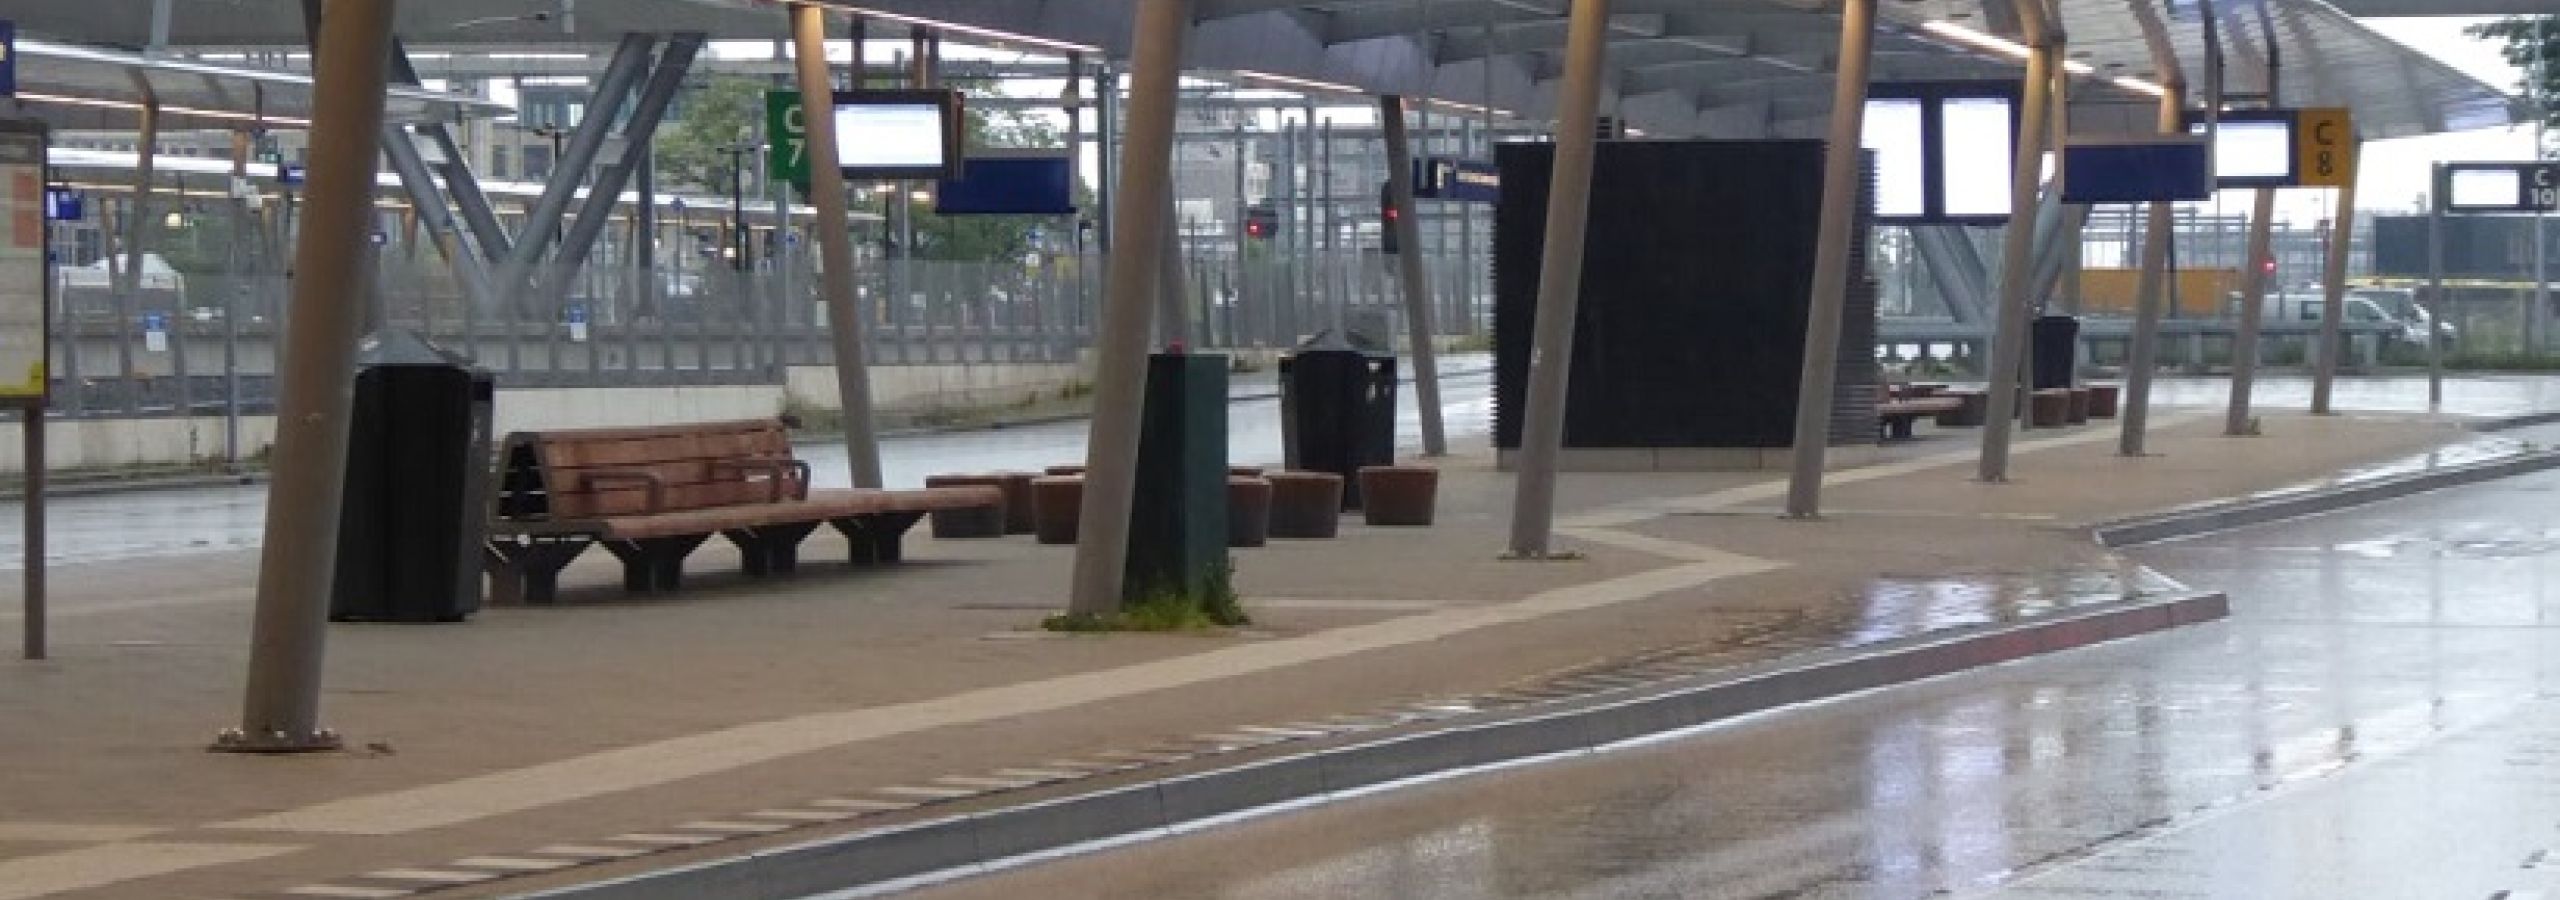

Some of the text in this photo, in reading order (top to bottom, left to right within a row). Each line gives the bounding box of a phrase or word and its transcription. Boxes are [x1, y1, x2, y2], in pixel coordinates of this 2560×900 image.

[784, 103, 805, 133] C
[2314, 120, 2334, 145] C
[786, 138, 805, 167] 7
[2316, 150, 2333, 176] 8
[2534, 168, 2550, 186] C
[2531, 187, 2555, 206] 10
